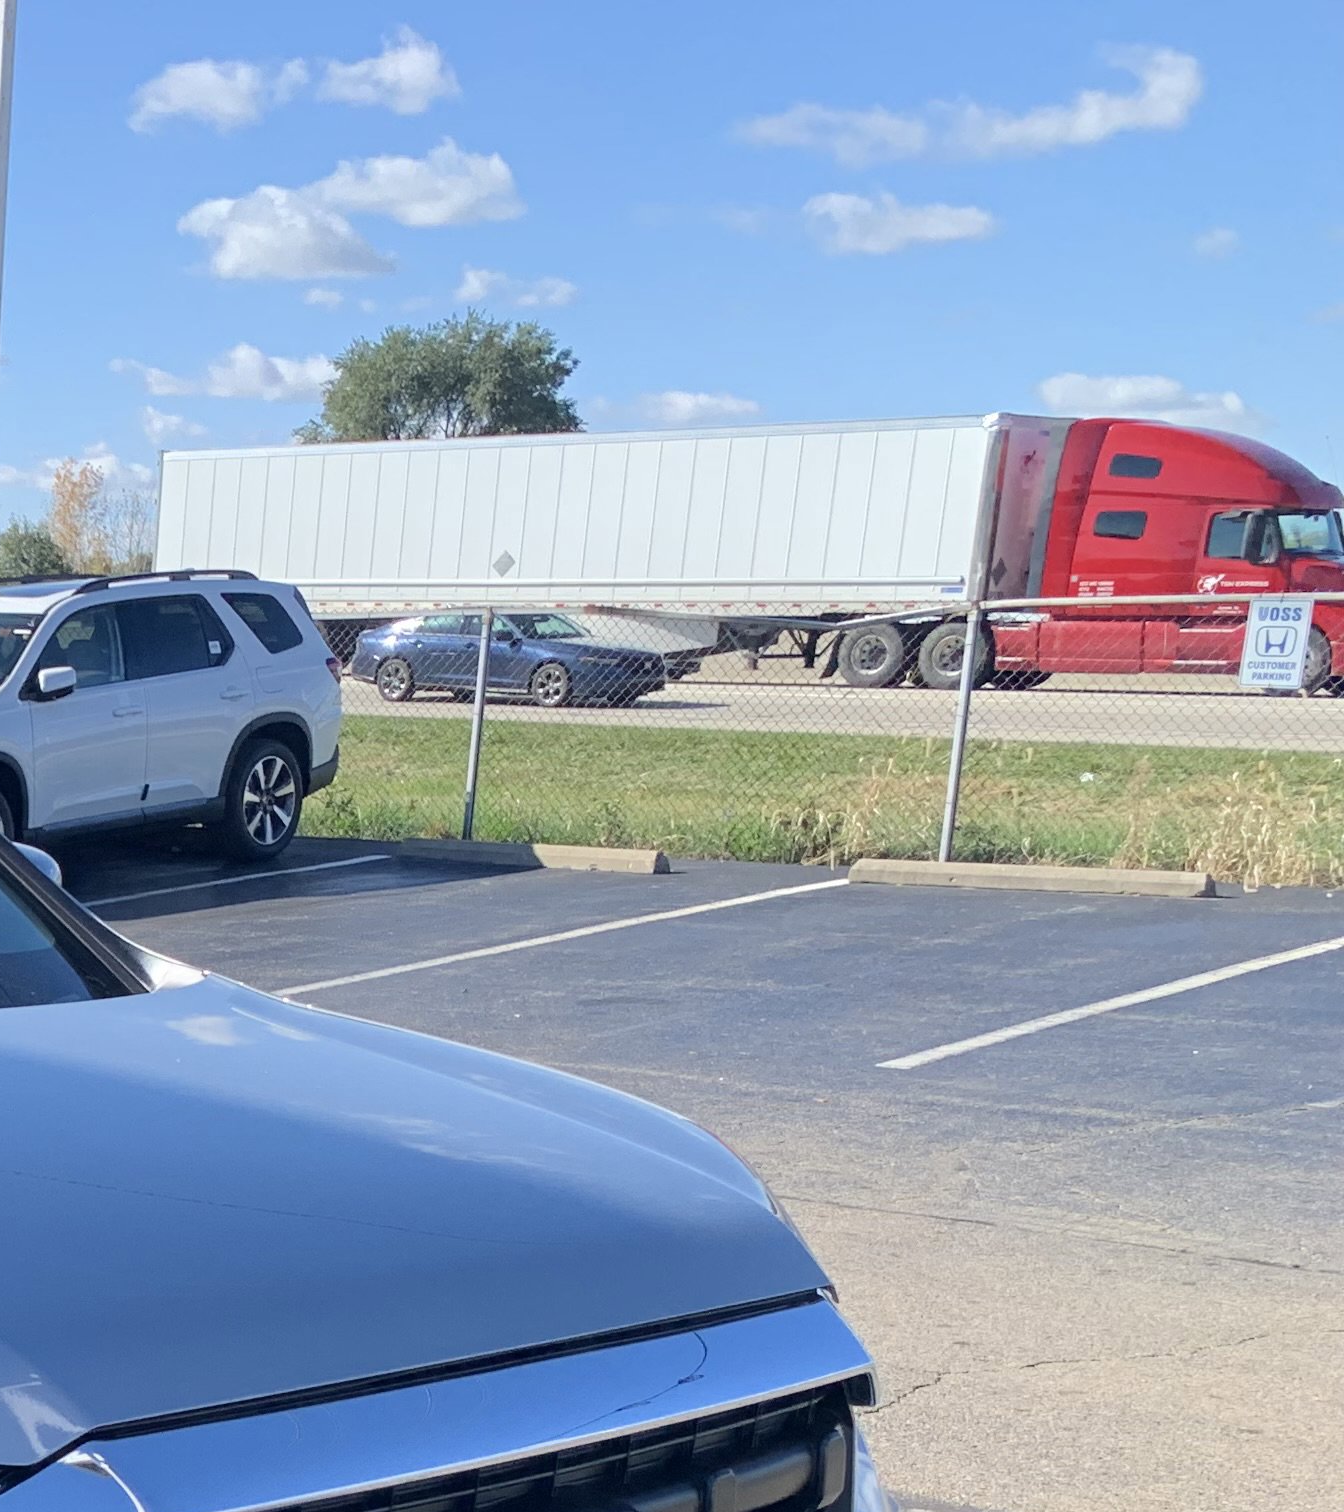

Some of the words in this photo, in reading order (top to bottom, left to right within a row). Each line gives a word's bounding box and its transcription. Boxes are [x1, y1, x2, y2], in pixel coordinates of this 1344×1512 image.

[1258, 607, 1303, 621] VOSS
[1247, 661, 1296, 670] CUSTOMER
[1251, 672, 1292, 681] PARKING
